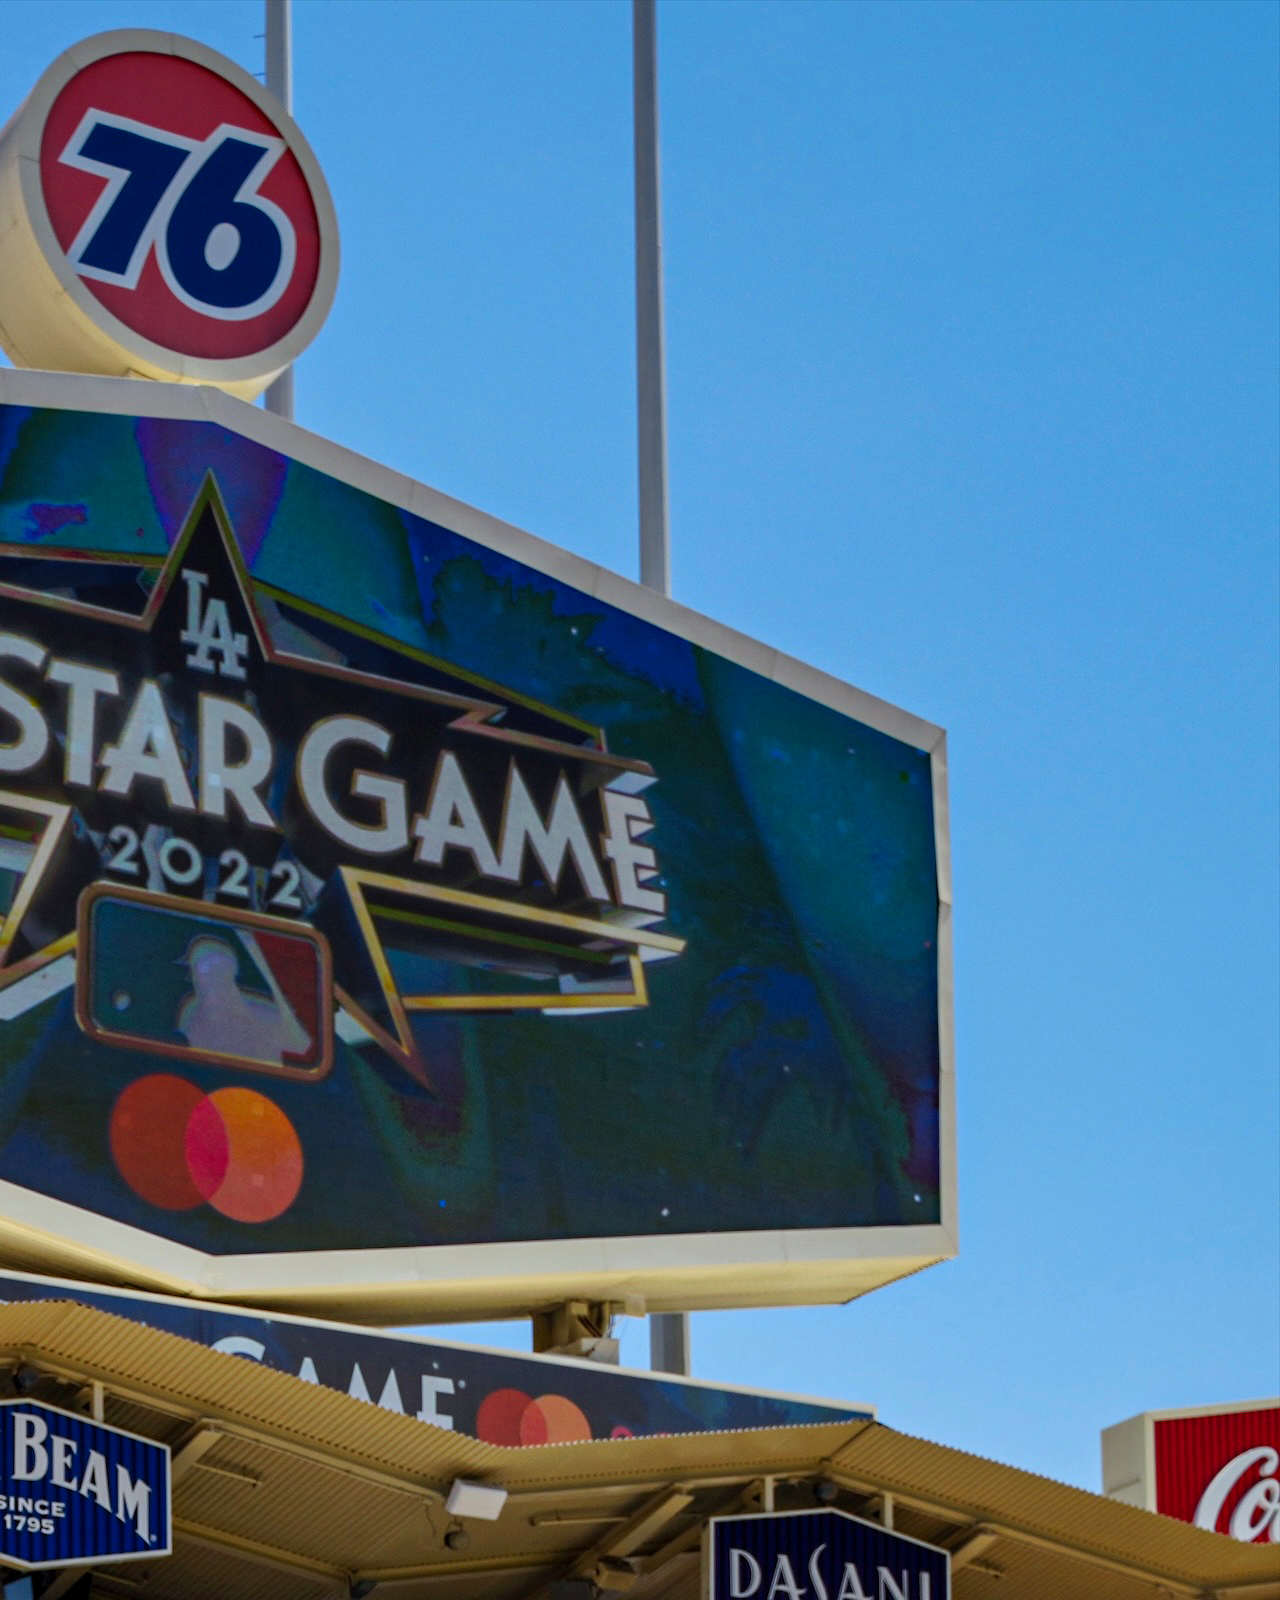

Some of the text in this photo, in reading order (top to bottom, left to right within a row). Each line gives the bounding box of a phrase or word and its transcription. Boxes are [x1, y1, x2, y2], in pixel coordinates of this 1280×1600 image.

[58, 106, 297, 321] 76
[179, 569, 248, 680] LA
[109, 825, 303, 908] 2022
[295, 712, 666, 918] GAME
[4, 1514, 56, 1535] 1795
[10, 1411, 152, 1546] BEAM
[1193, 1445, 1280, 1543] Co
